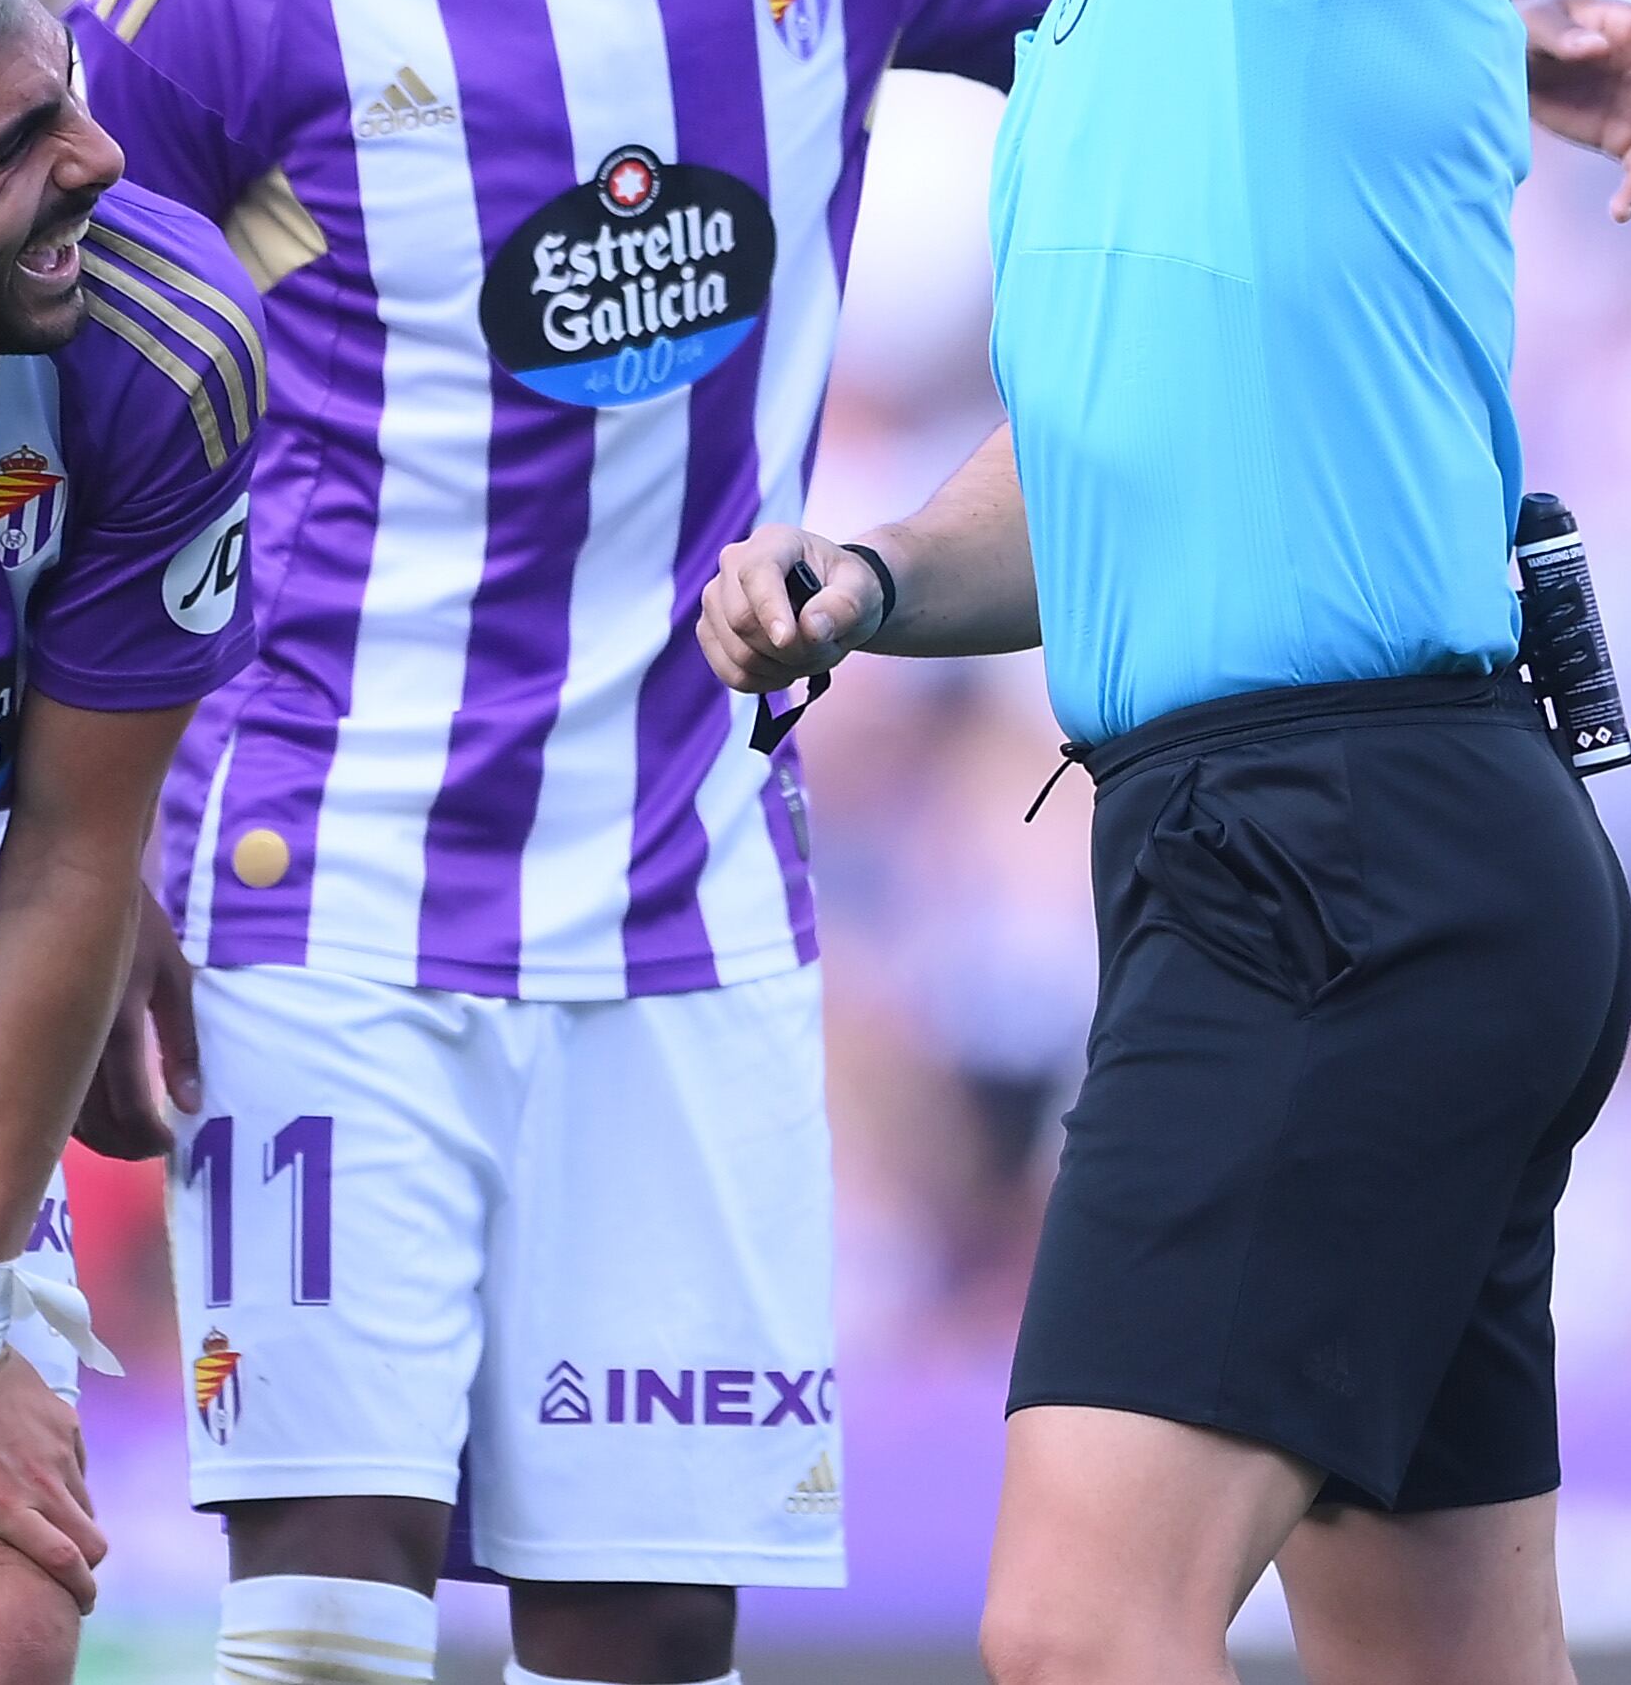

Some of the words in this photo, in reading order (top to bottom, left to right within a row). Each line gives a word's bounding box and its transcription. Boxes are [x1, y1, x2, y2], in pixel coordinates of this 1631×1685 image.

[358, 106, 456, 137] adidas
[532, 206, 736, 295] Estrella
[543, 266, 728, 351] Galicia
[183, 1115, 333, 1309] 11
